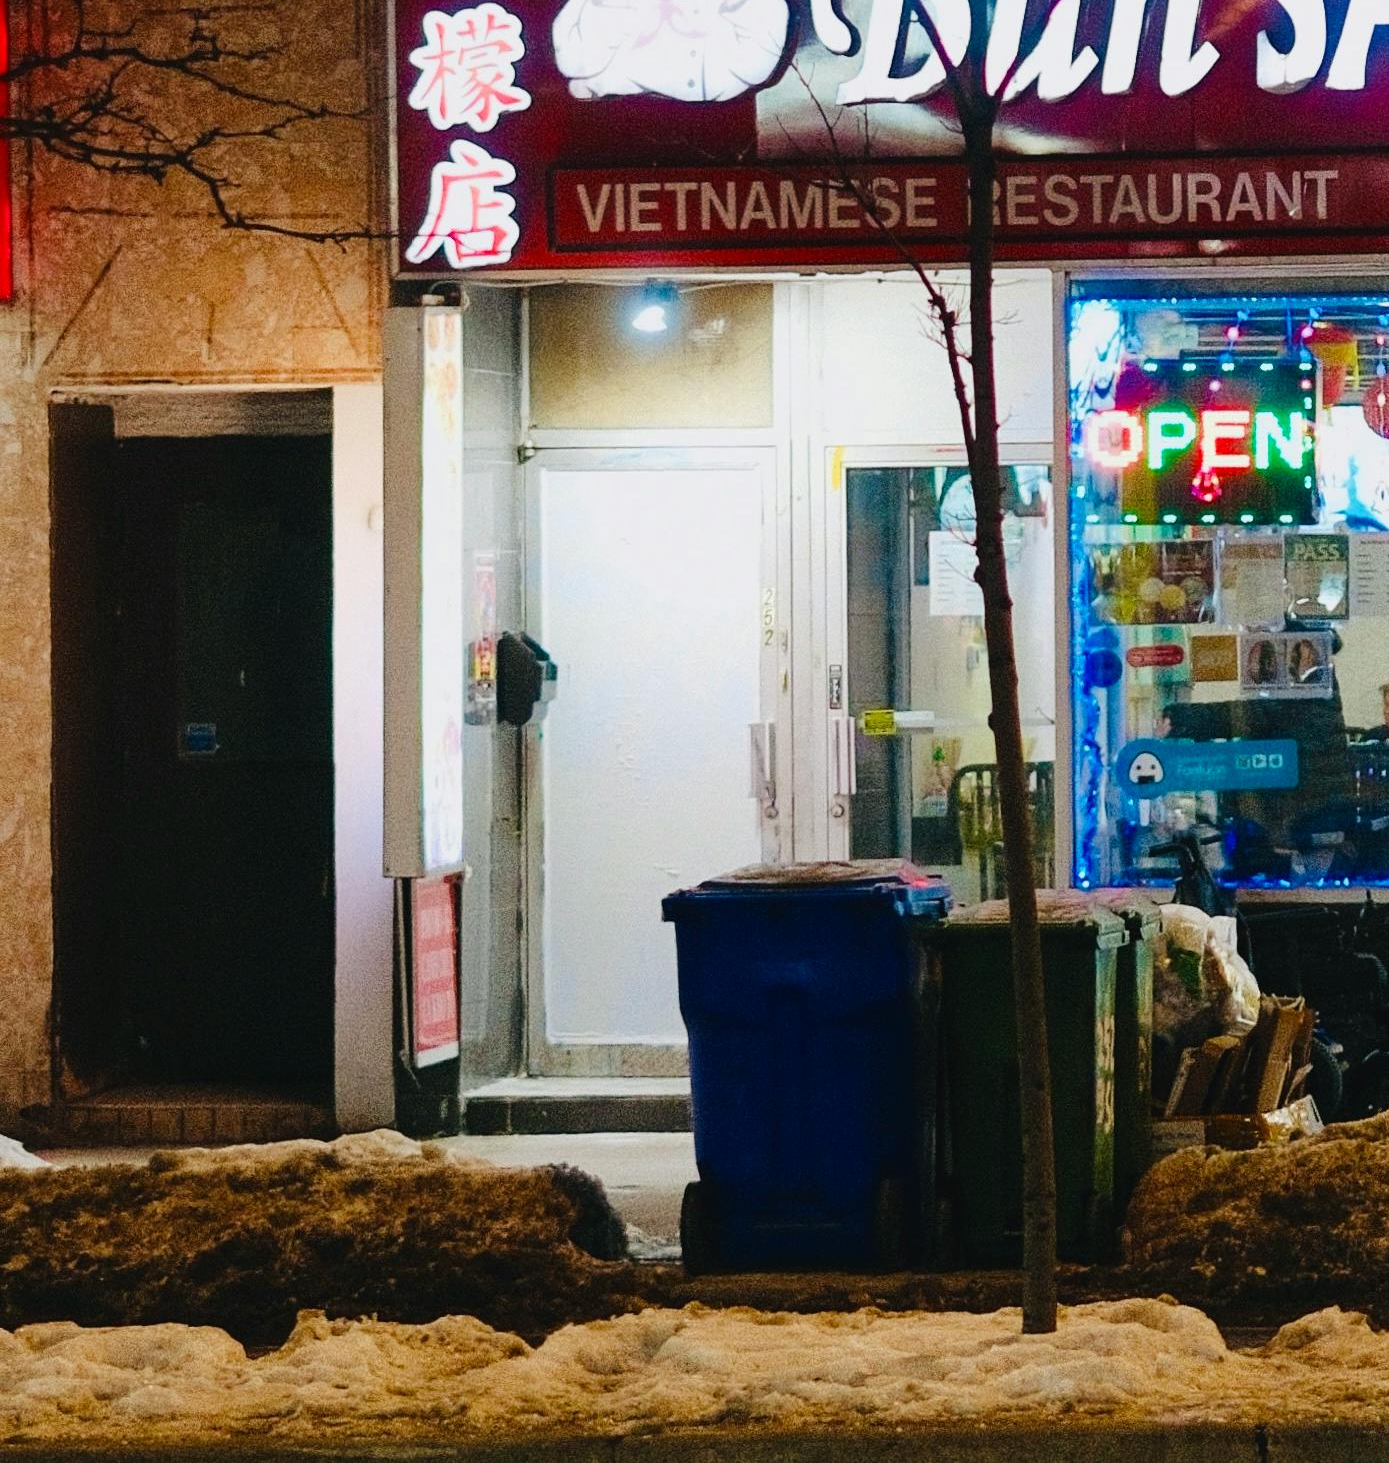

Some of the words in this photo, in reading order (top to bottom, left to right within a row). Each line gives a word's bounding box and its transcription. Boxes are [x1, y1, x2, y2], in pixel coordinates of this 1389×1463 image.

[577, 177, 938, 232] VIETNAMESE
[1088, 410, 1305, 470] OPEN
[1294, 543, 1340, 562] PASS
